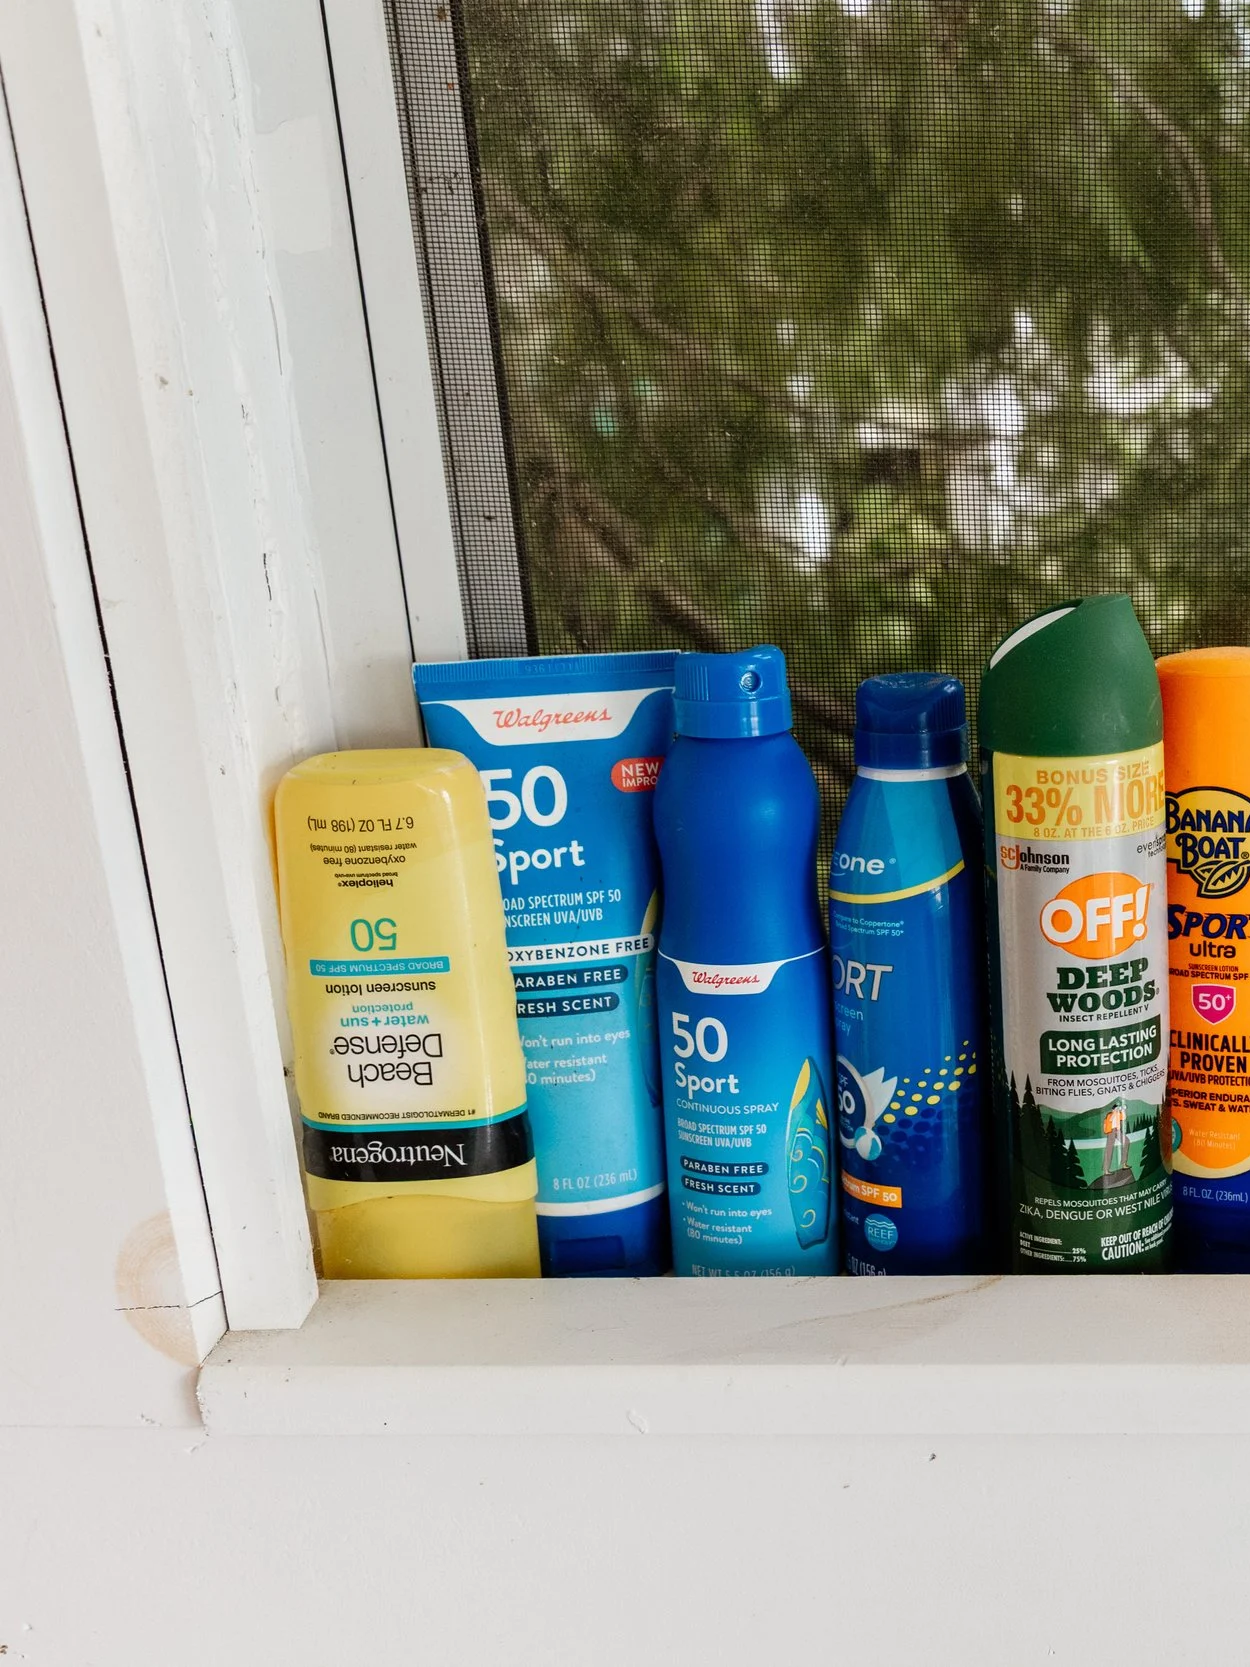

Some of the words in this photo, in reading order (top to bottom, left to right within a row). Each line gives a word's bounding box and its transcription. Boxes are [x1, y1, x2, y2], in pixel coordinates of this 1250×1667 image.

[493, 708, 612, 732] Walgreens
[622, 762, 659, 778] NEW
[1036, 768, 1108, 785] BONUS
[1116, 760, 1150, 780] SIZE
[480, 766, 568, 830] 50
[1006, 784, 1083, 826] 33%
[1094, 770, 1165, 824] MORE
[1176, 832, 1246, 868] BOAT
[324, 856, 342, 866] free
[344, 856, 406, 866] oxybenzone
[493, 838, 586, 885] Sport
[529, 892, 583, 910] SPECTRUM
[587, 890, 605, 904] SPF
[608, 889, 622, 902] 50
[554, 908, 603, 924] UVA/UVB
[1042, 883, 1151, 944] OFF!
[350, 918, 397, 952] 50
[616, 938, 649, 952] FREE
[1189, 941, 1236, 959] ultra
[584, 969, 621, 982] FREE
[1056, 958, 1148, 990] DEEP
[1188, 963, 1218, 972] SUNSCREEN
[1219, 964, 1239, 972] LOTION
[1191, 970, 1232, 980] SPECTRUM
[1232, 972, 1249, 980] SPF
[326, 983, 362, 996] lotion
[366, 980, 436, 993] sunscreen
[692, 972, 760, 988] Walgreens
[563, 996, 612, 1012] SCENT
[1046, 980, 1156, 1013] WOODS
[352, 1000, 414, 1014] protection
[551, 1036, 573, 1047] run
[576, 1033, 601, 1044] into
[604, 1030, 630, 1044] eyes
[672, 1012, 728, 1062] 50
[1049, 1038, 1096, 1052] LONG
[1100, 1025, 1157, 1050] LASTING
[554, 1054, 608, 1068] resistant
[1056, 1043, 1152, 1068] PROTECTION
[1180, 1052, 1248, 1074] PROVEN
[348, 1062, 433, 1088] Beach
[674, 1062, 740, 1099] Sport
[1036, 1086, 1066, 1096] BITING
[1068, 1088, 1095, 1097] FLIES,
[1097, 1084, 1126, 1096] GNATS
[1128, 1082, 1134, 1090] &
[1136, 1068, 1166, 1088] CHIGGERS
[676, 1098, 741, 1114] CONTINUOUS
[743, 1102, 780, 1114] SPRAY
[1183, 1100, 1217, 1112] SWEAT
[1218, 1103, 1226, 1112] &
[678, 1118, 696, 1132] BROAD
[698, 1123, 738, 1136] SPECTRUM
[740, 1124, 754, 1134] SPF
[756, 1124, 767, 1134] 50
[332, 1141, 468, 1167] Neutrogena
[684, 1160, 729, 1174] PARABEN
[734, 1164, 764, 1174] FREE
[684, 1178, 714, 1192] FRESH
[718, 1184, 756, 1194] SCENT
[860, 1184, 880, 1199] SPF
[882, 1192, 898, 1202] 50
[1034, 1196, 1062, 1208] REPELS
[1063, 1198, 1118, 1208] MOSQUITOES
[1119, 1192, 1138, 1203] THAT
[1138, 1187, 1152, 1198] MAY
[1152, 1178, 1168, 1193] CARRY
[686, 1200, 710, 1214] Won't
[710, 1208, 726, 1217] run
[728, 1208, 748, 1217] into
[750, 1208, 772, 1219] eyes
[1020, 1203, 1044, 1219] ZIKA,
[1046, 1209, 1094, 1221] DENGUE
[1096, 1208, 1113, 1220] OR
[1114, 1202, 1142, 1217] WEST
[1144, 1194, 1160, 1210] NILE
[868, 1226, 894, 1240] REEF
[1100, 1236, 1117, 1248] KEEP
[1118, 1232, 1132, 1245] OUT
[1132, 1230, 1142, 1242] OF
[1142, 1222, 1158, 1238] REACH
[1102, 1241, 1144, 1261] CAUTION:
